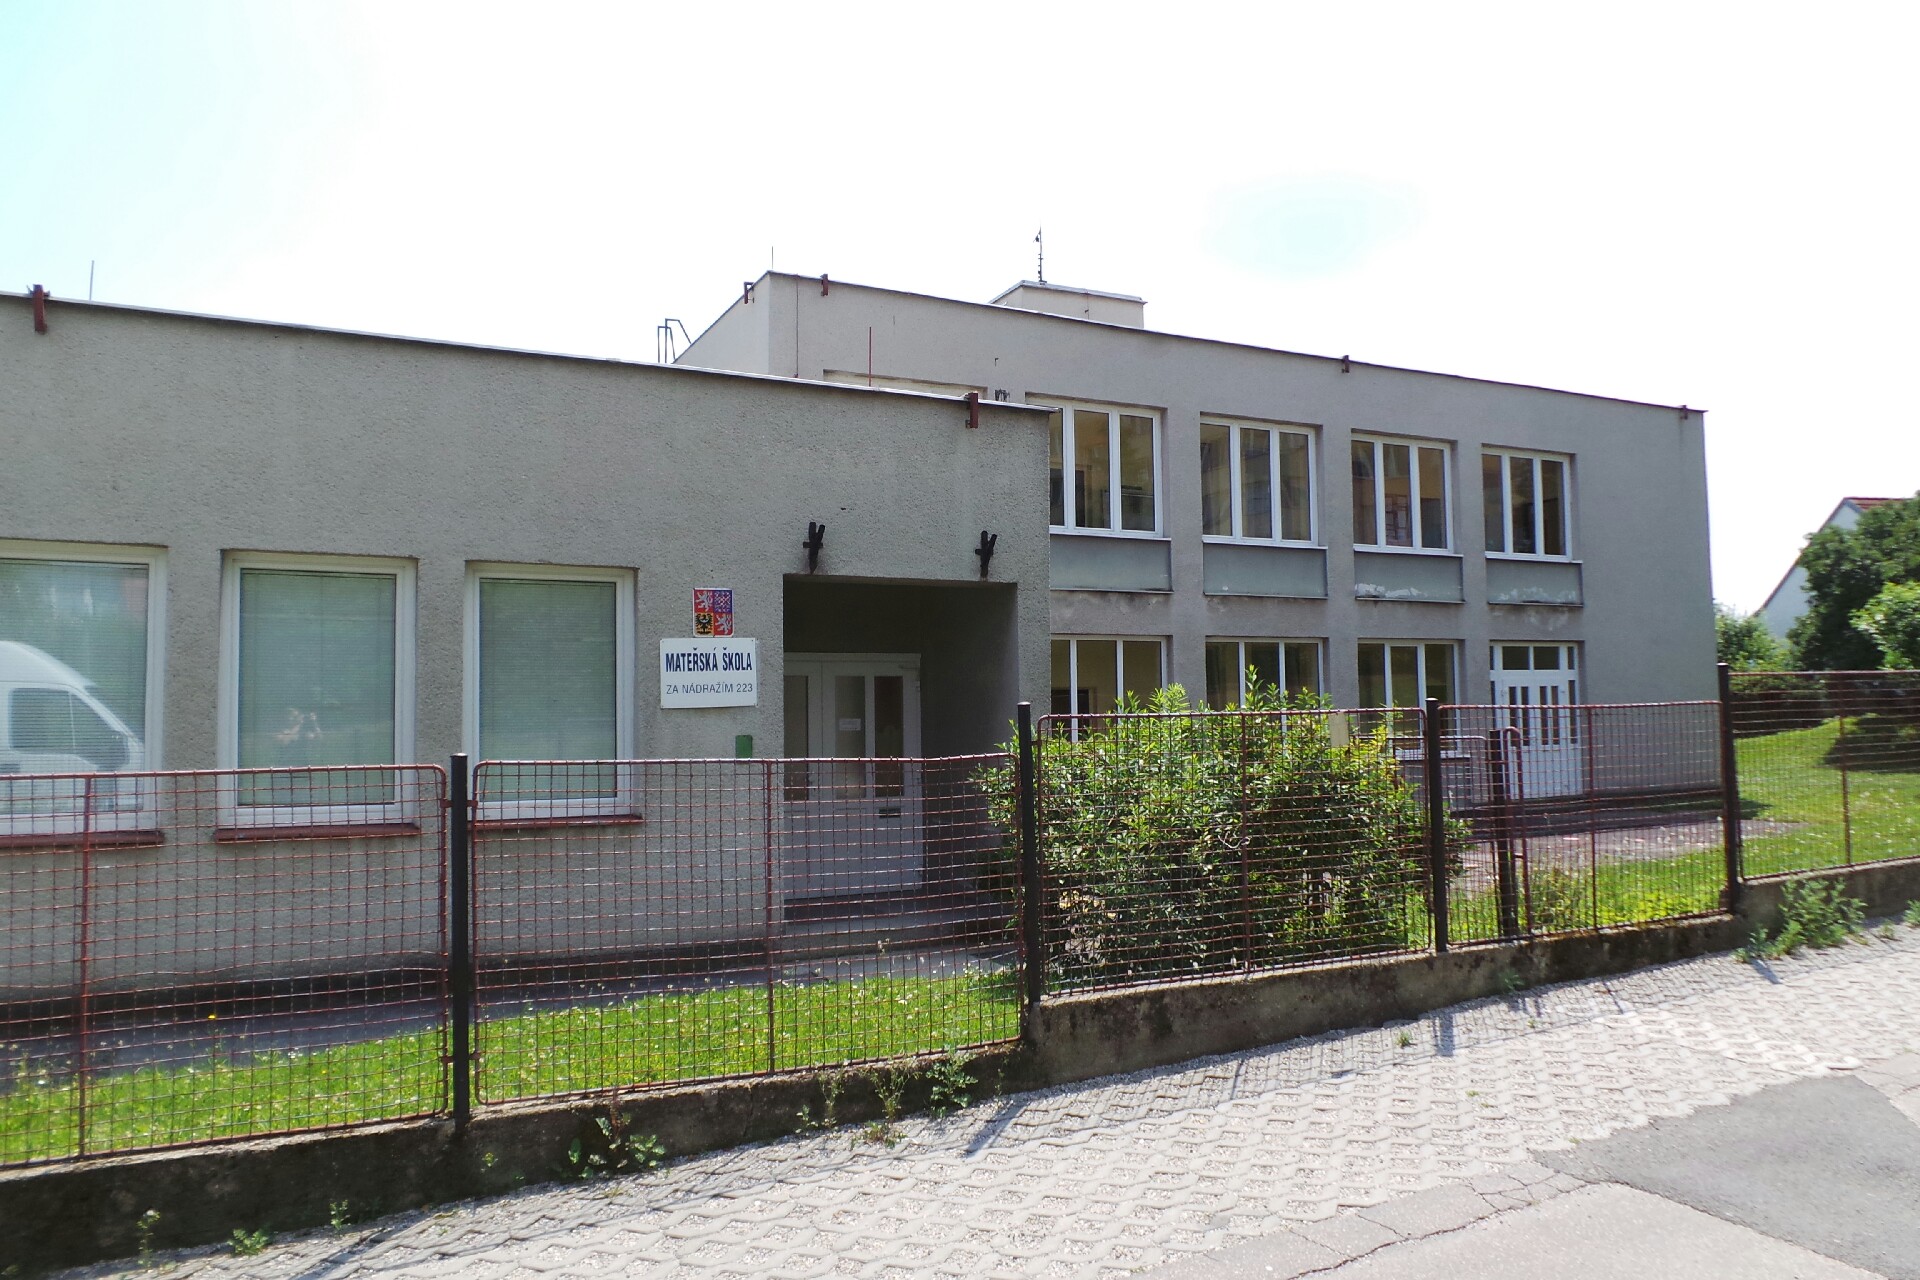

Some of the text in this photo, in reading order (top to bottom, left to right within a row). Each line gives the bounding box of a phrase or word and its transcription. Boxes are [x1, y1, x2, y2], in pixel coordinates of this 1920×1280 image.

[665, 647, 752, 672] MATEŘSKÁ ŠKOLA
[666, 681, 753, 694] ZA NÁDRAŽÍM 223
